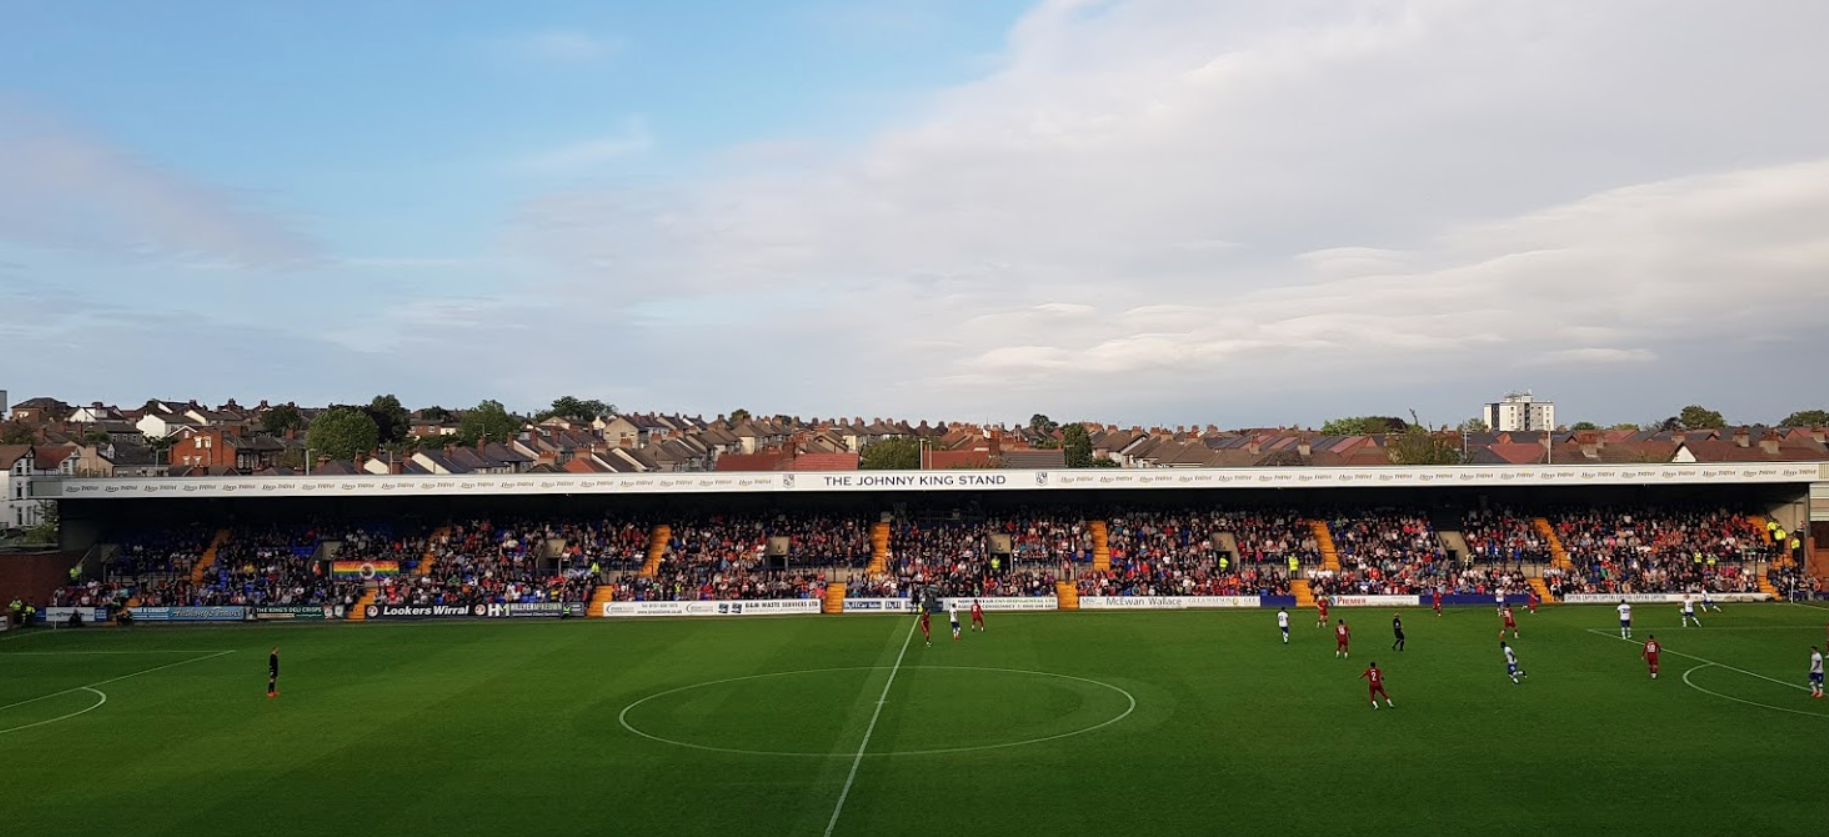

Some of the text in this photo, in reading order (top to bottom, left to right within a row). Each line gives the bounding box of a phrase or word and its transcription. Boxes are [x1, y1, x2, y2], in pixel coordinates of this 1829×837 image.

[824, 475, 1006, 486] THE JOHNNY KING STAND
[1106, 597, 1144, 606] McEwan
[1149, 597, 1182, 605] Wallace
[383, 605, 469, 615] Lookers Wirral
[488, 603, 510, 617] HM
[1371, 671, 1377, 681] 2
